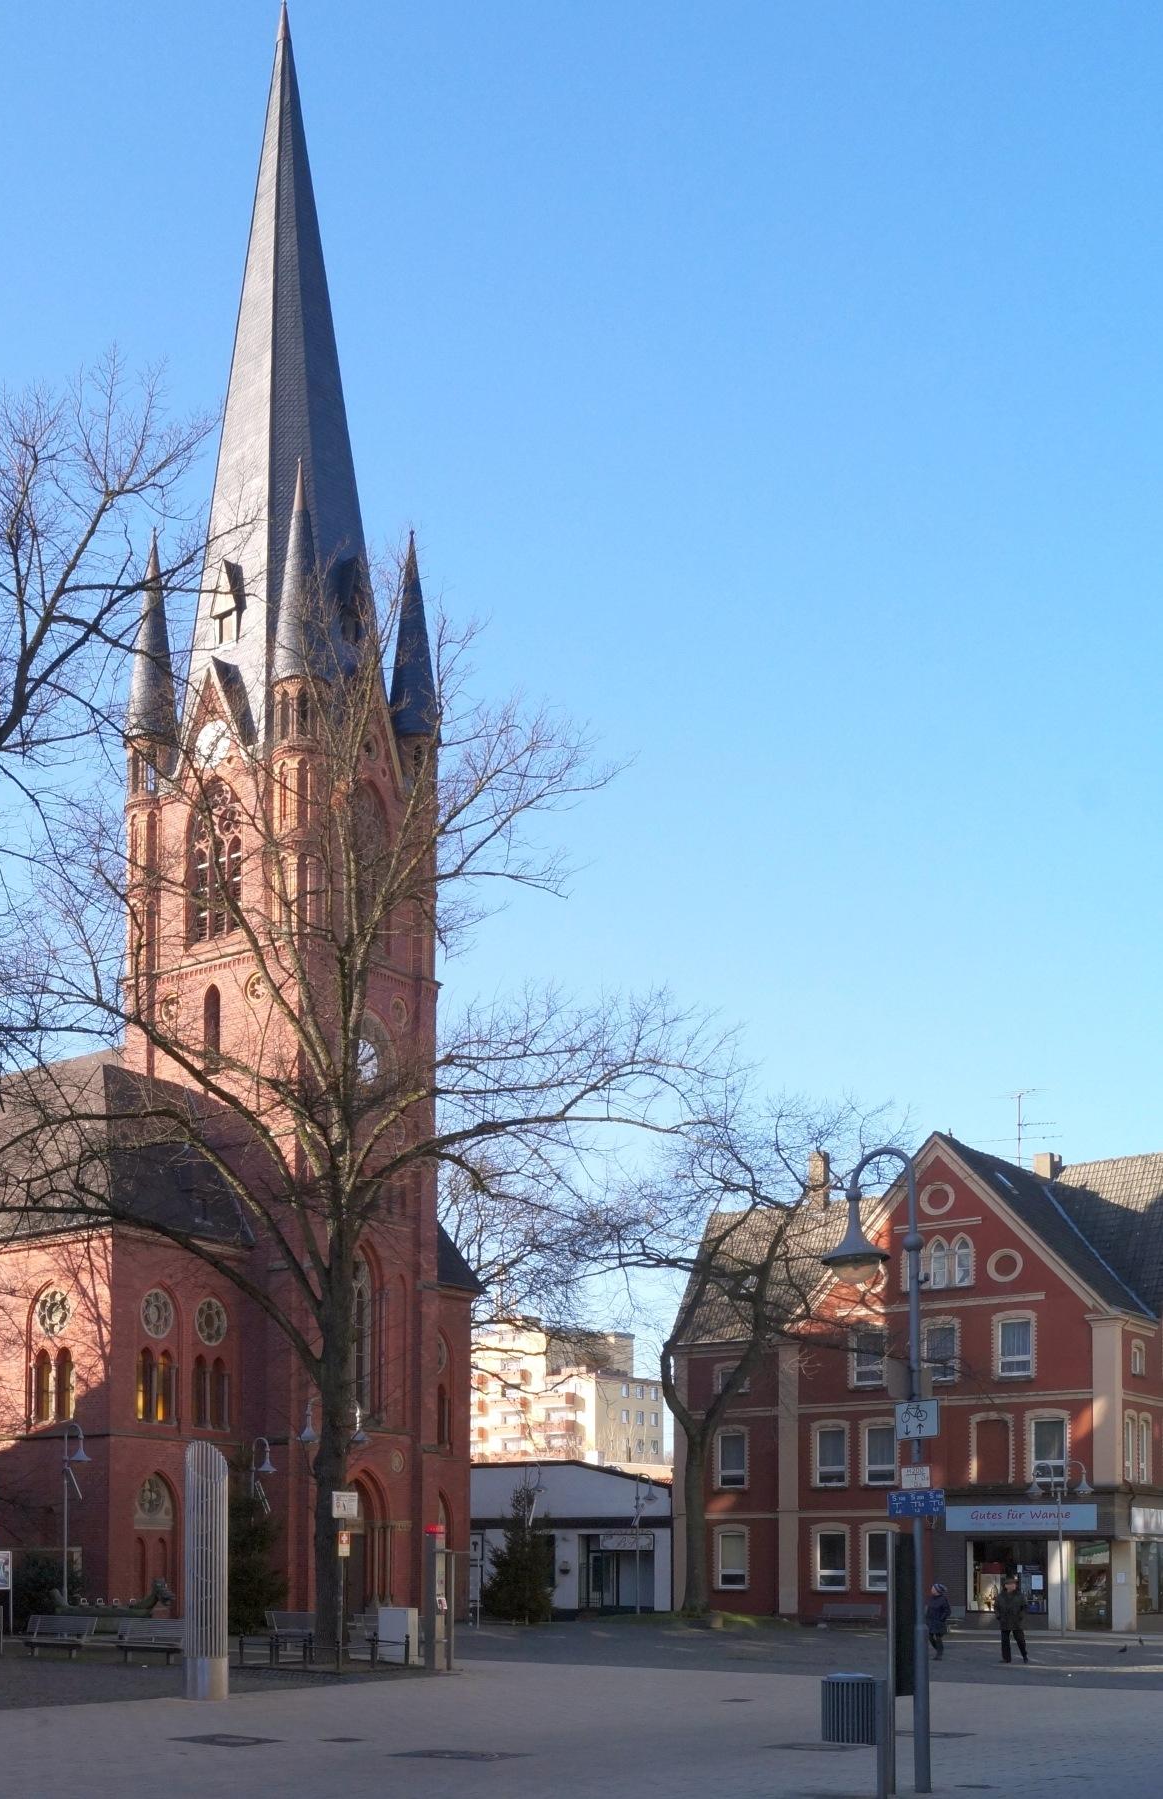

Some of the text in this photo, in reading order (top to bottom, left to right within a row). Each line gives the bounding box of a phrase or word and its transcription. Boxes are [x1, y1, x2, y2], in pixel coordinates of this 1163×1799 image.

[970, 1508, 1071, 1520] Gutes für Wanne
